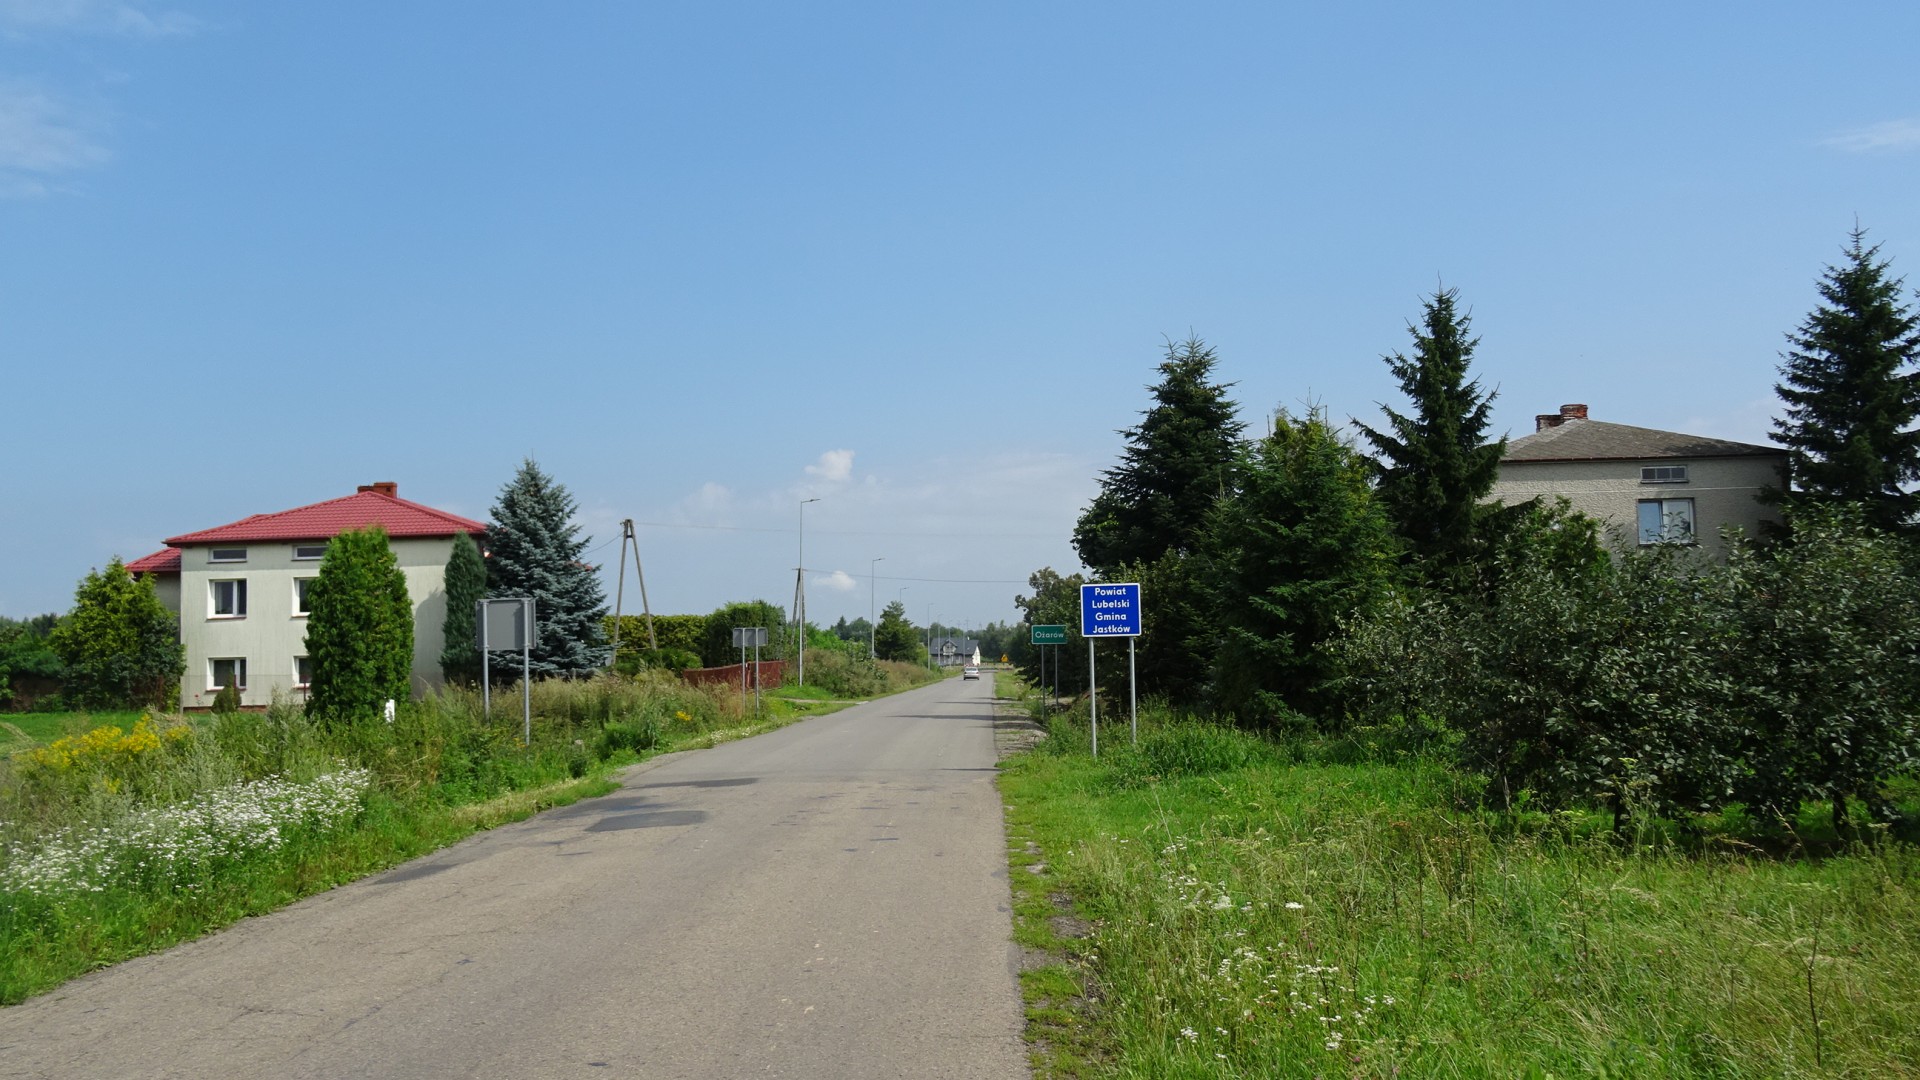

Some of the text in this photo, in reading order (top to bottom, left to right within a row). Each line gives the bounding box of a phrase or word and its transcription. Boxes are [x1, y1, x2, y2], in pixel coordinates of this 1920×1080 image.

[1095, 587, 1126, 596] Powiat
[1092, 599, 1130, 608] Lubelski
[1095, 612, 1127, 621] Gmina
[1093, 625, 1130, 633] Jastków
